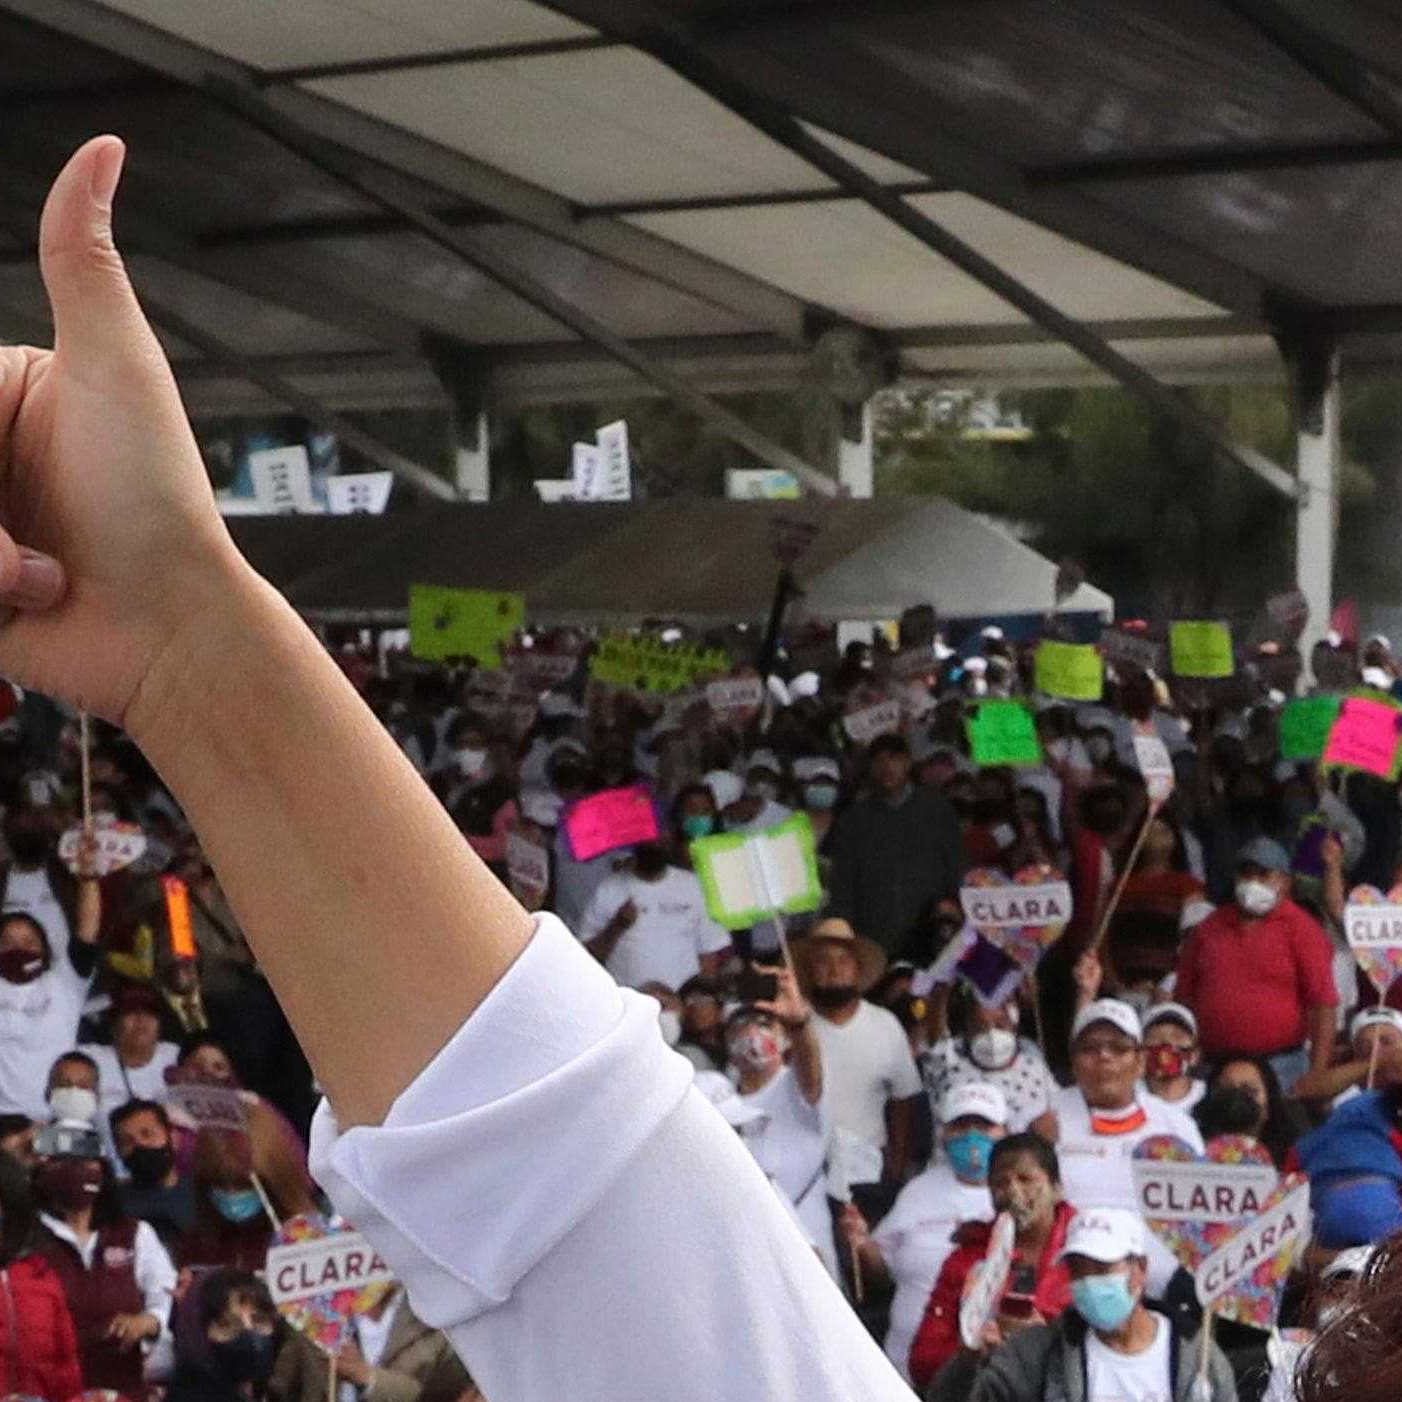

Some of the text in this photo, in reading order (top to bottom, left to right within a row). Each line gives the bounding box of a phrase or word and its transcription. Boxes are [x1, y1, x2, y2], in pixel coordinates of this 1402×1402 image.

[972, 899, 1060, 921] CLARA
[1142, 1182, 1259, 1214] CLARA
[1204, 1212, 1297, 1292] CLARA
[276, 1251, 388, 1292] CLARA
